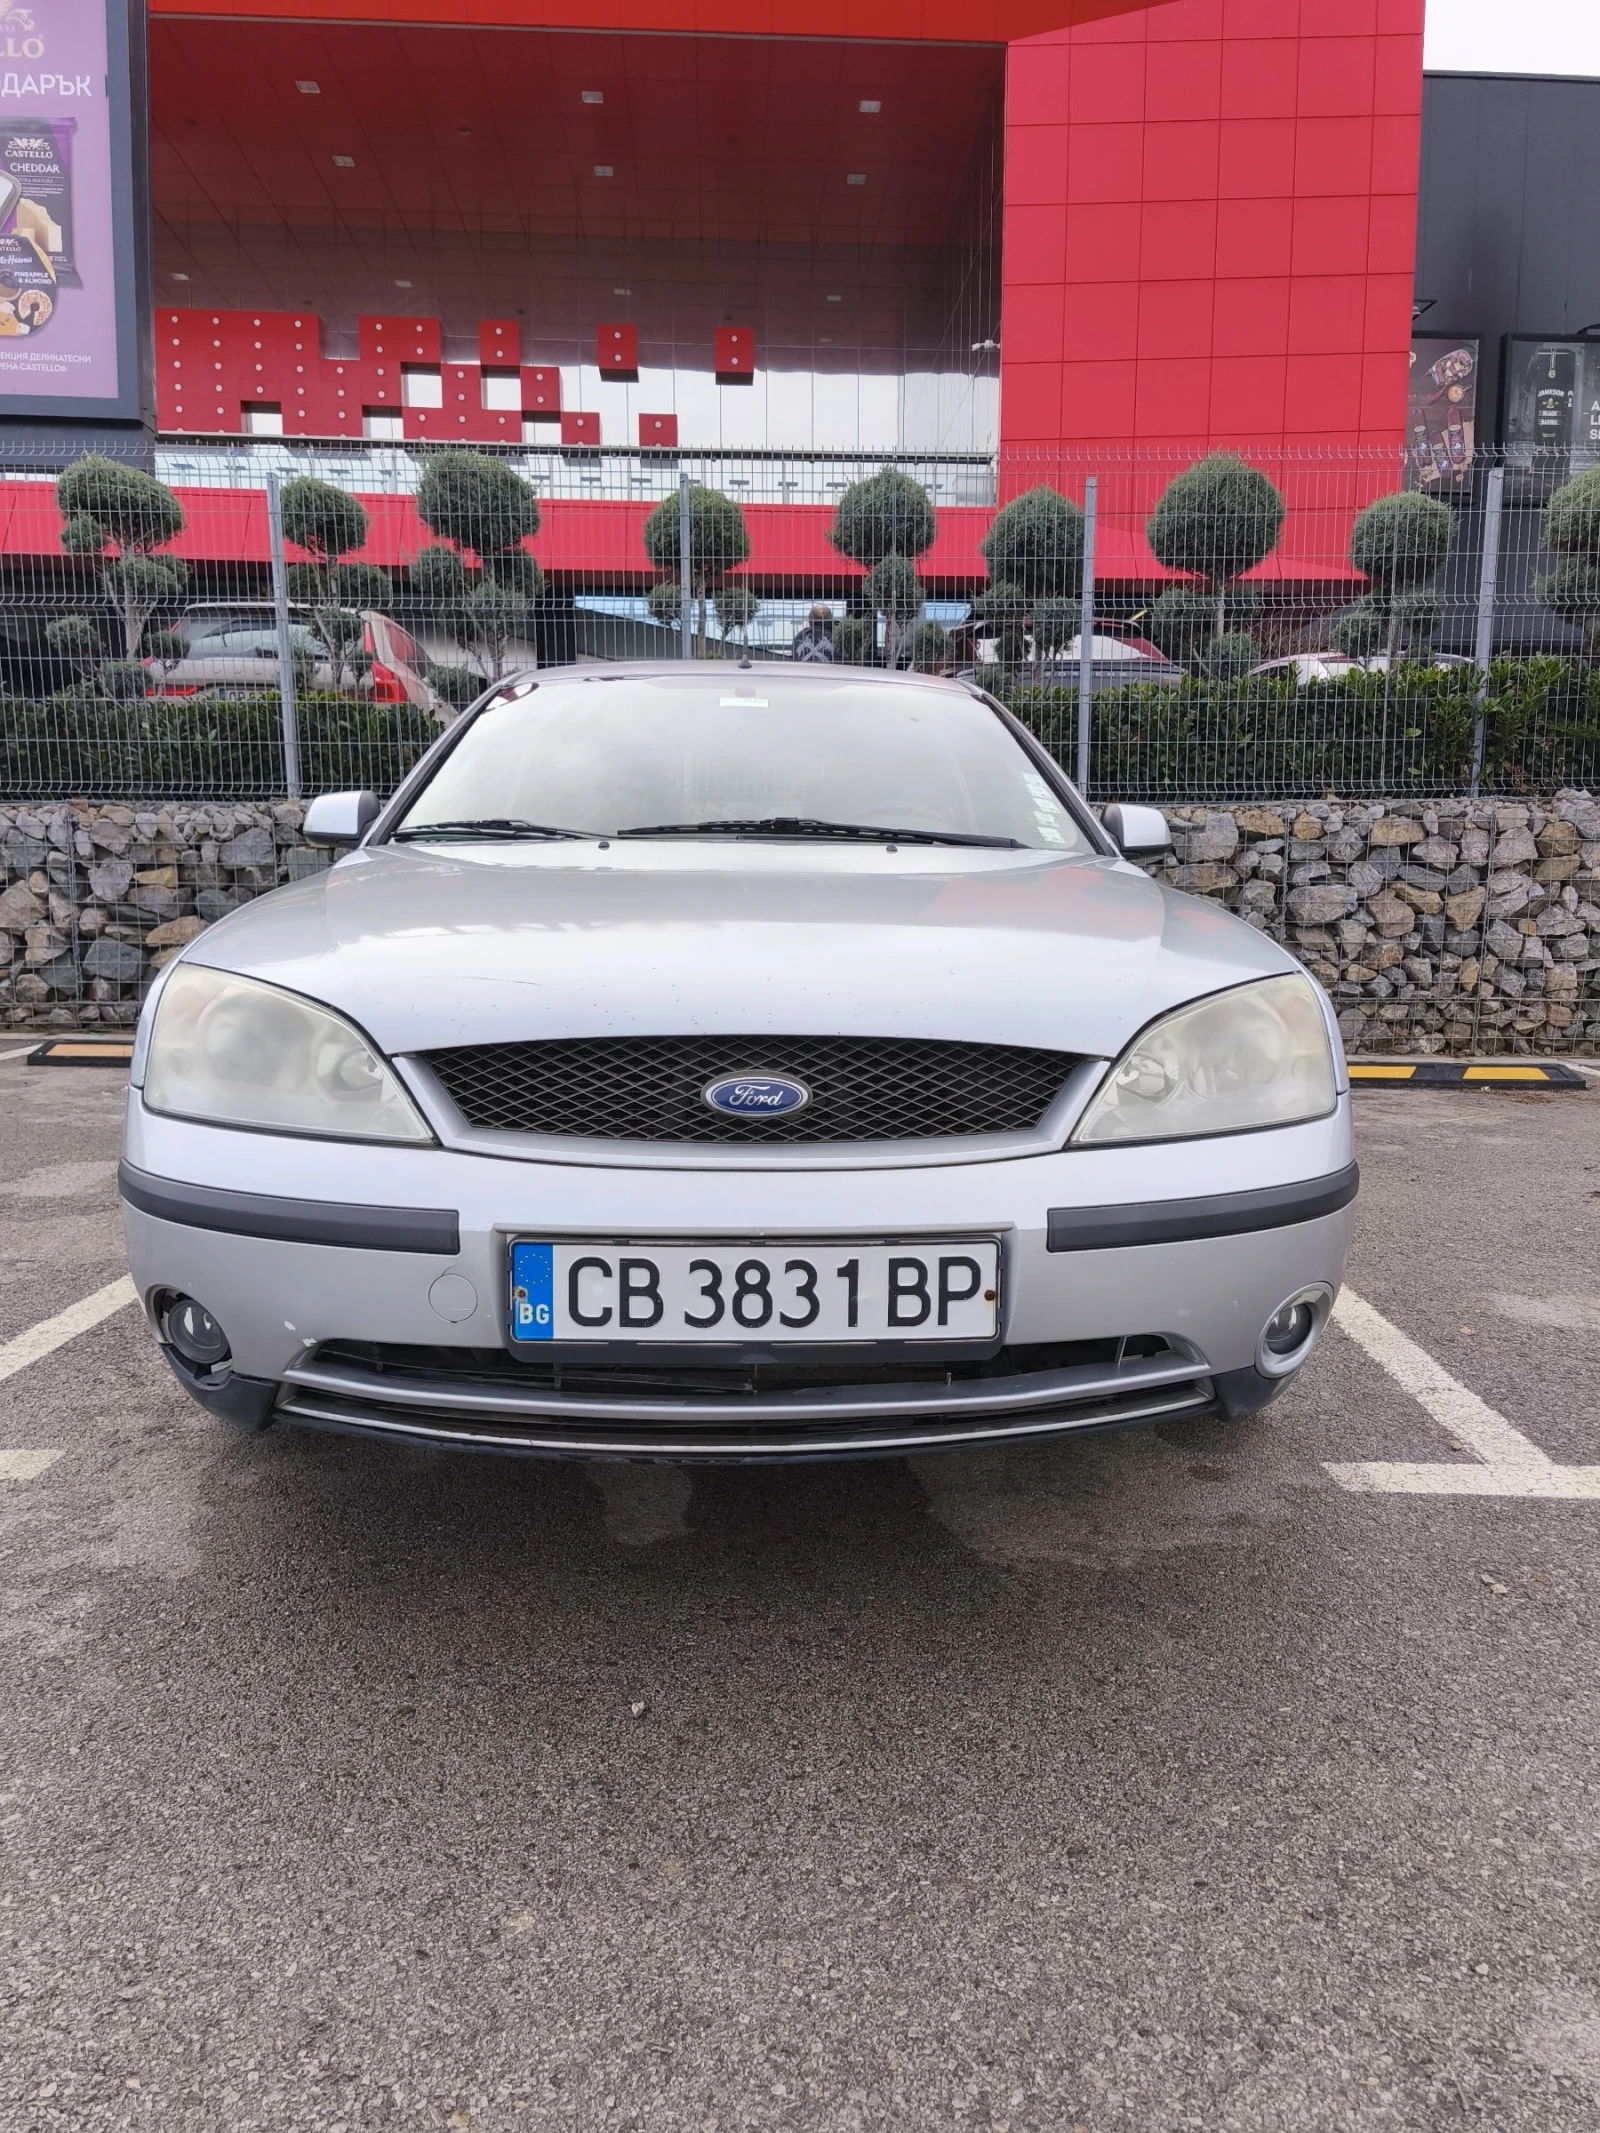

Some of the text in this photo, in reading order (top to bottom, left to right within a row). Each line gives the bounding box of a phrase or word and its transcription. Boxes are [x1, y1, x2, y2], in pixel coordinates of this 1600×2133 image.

[0, 72, 93, 98] ДАРЪК
[5, 149, 53, 159] CASTELLO
[10, 162, 60, 173] CHEDDAR
[30, 352, 92, 363] ДЕЛИКАТЕСНИ
[1537, 389, 1565, 397] JAMESON
[1591, 415, 1600, 426] L
[1589, 429, 1600, 440] S
[728, 1084, 784, 1107] Ford
[519, 1255, 982, 1328] BG CB 3831 BP
